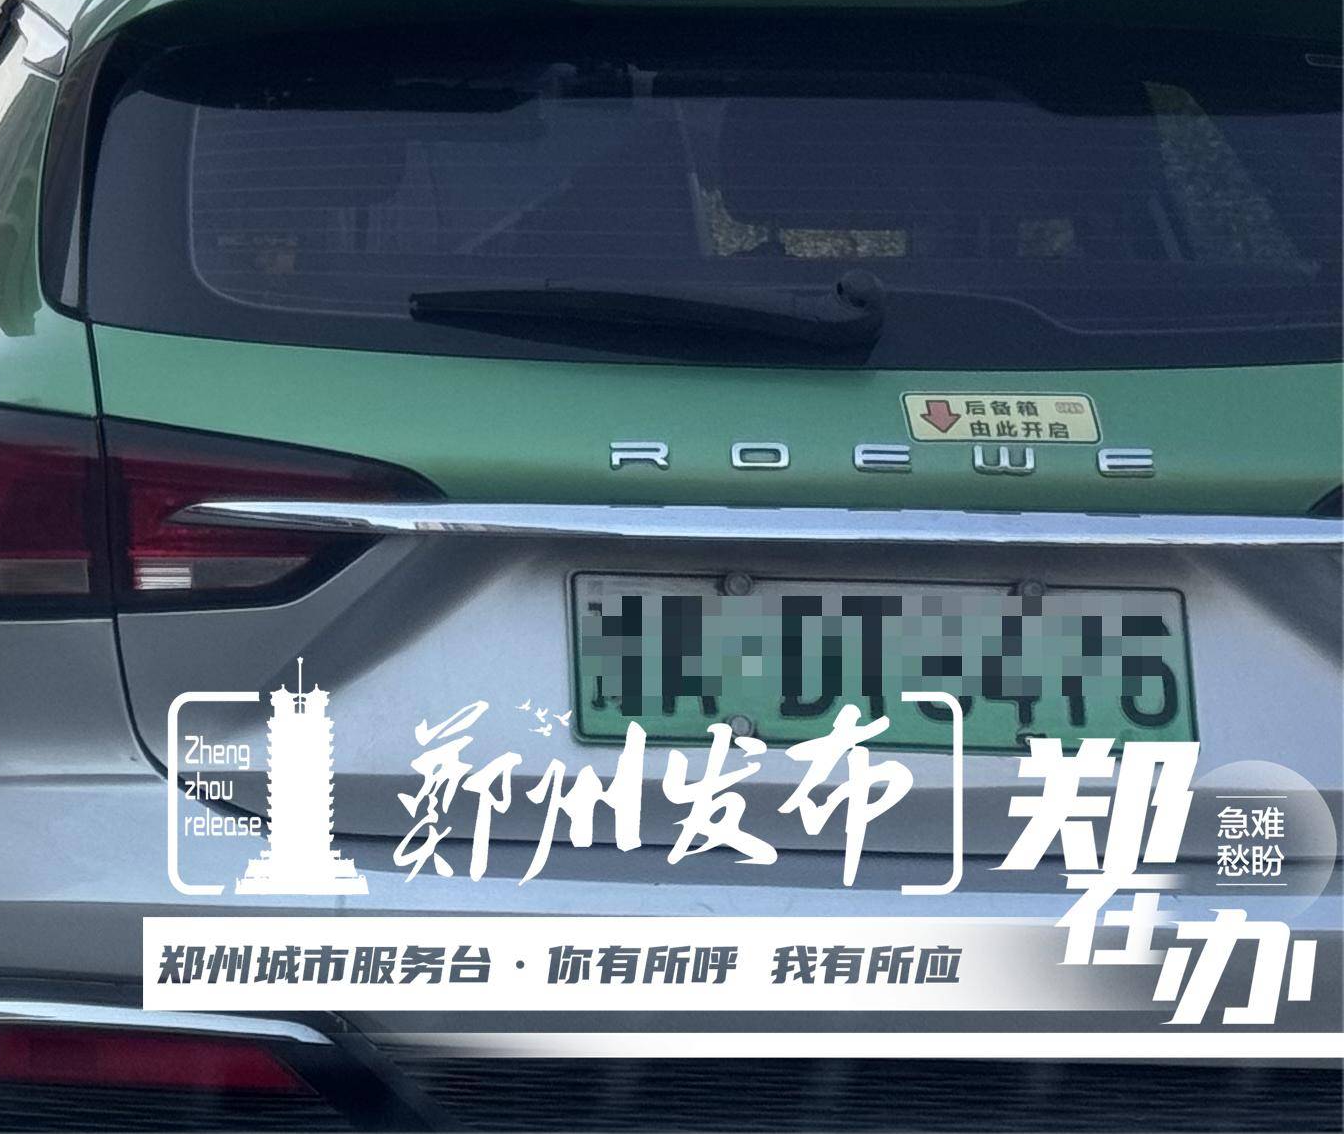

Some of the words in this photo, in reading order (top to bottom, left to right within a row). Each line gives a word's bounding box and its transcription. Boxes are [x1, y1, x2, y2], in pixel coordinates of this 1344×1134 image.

[965, 400, 1039, 417] 后备箱
[970, 419, 1070, 439] 由此开启
[609, 441, 1155, 478] ROEWE
